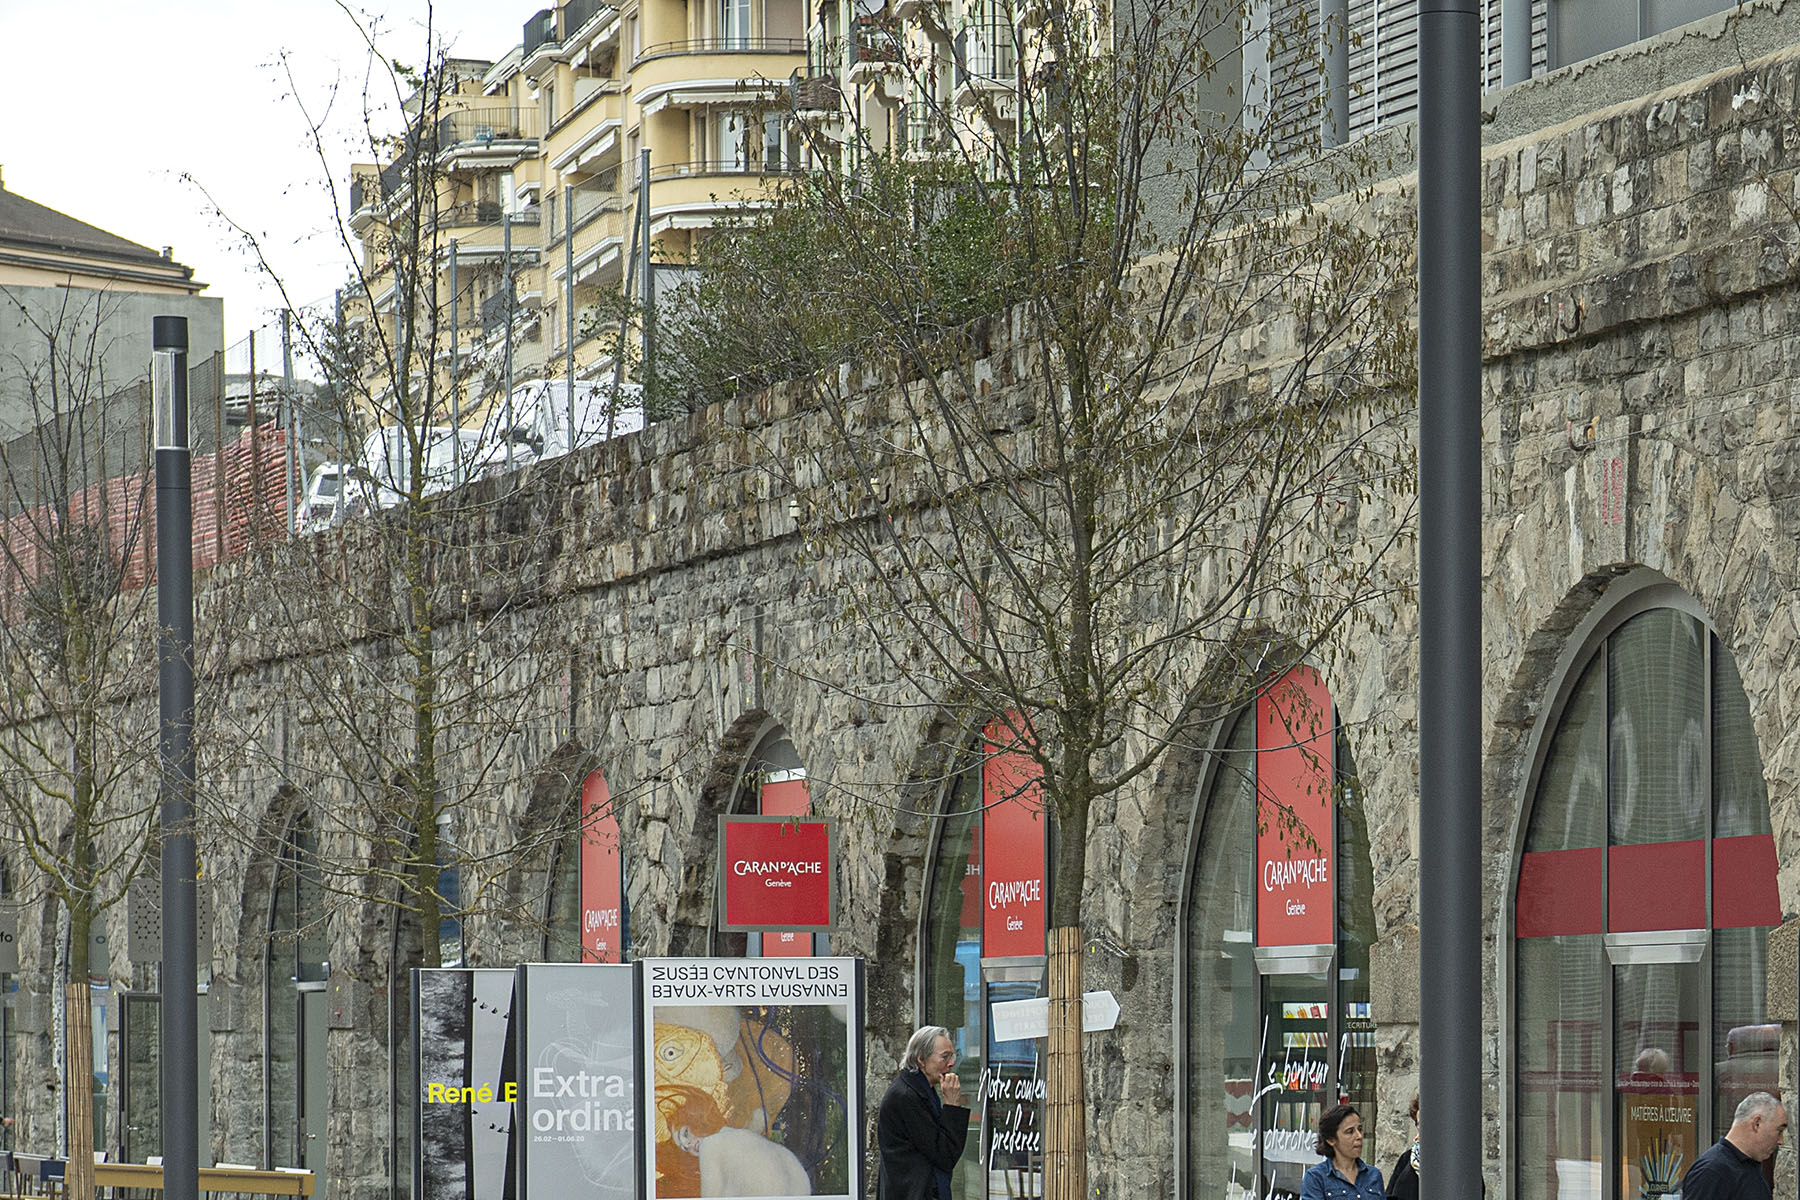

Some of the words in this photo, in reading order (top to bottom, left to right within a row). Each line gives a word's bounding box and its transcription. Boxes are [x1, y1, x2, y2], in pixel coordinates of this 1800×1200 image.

[765, 878, 792, 888] Genève
[1283, 1036, 1330, 1088] bonheur
[1015, 1052, 1048, 1102] couleu
[428, 1082, 492, 1103] René
[1630, 1105, 1658, 1121] MATIÈRES
